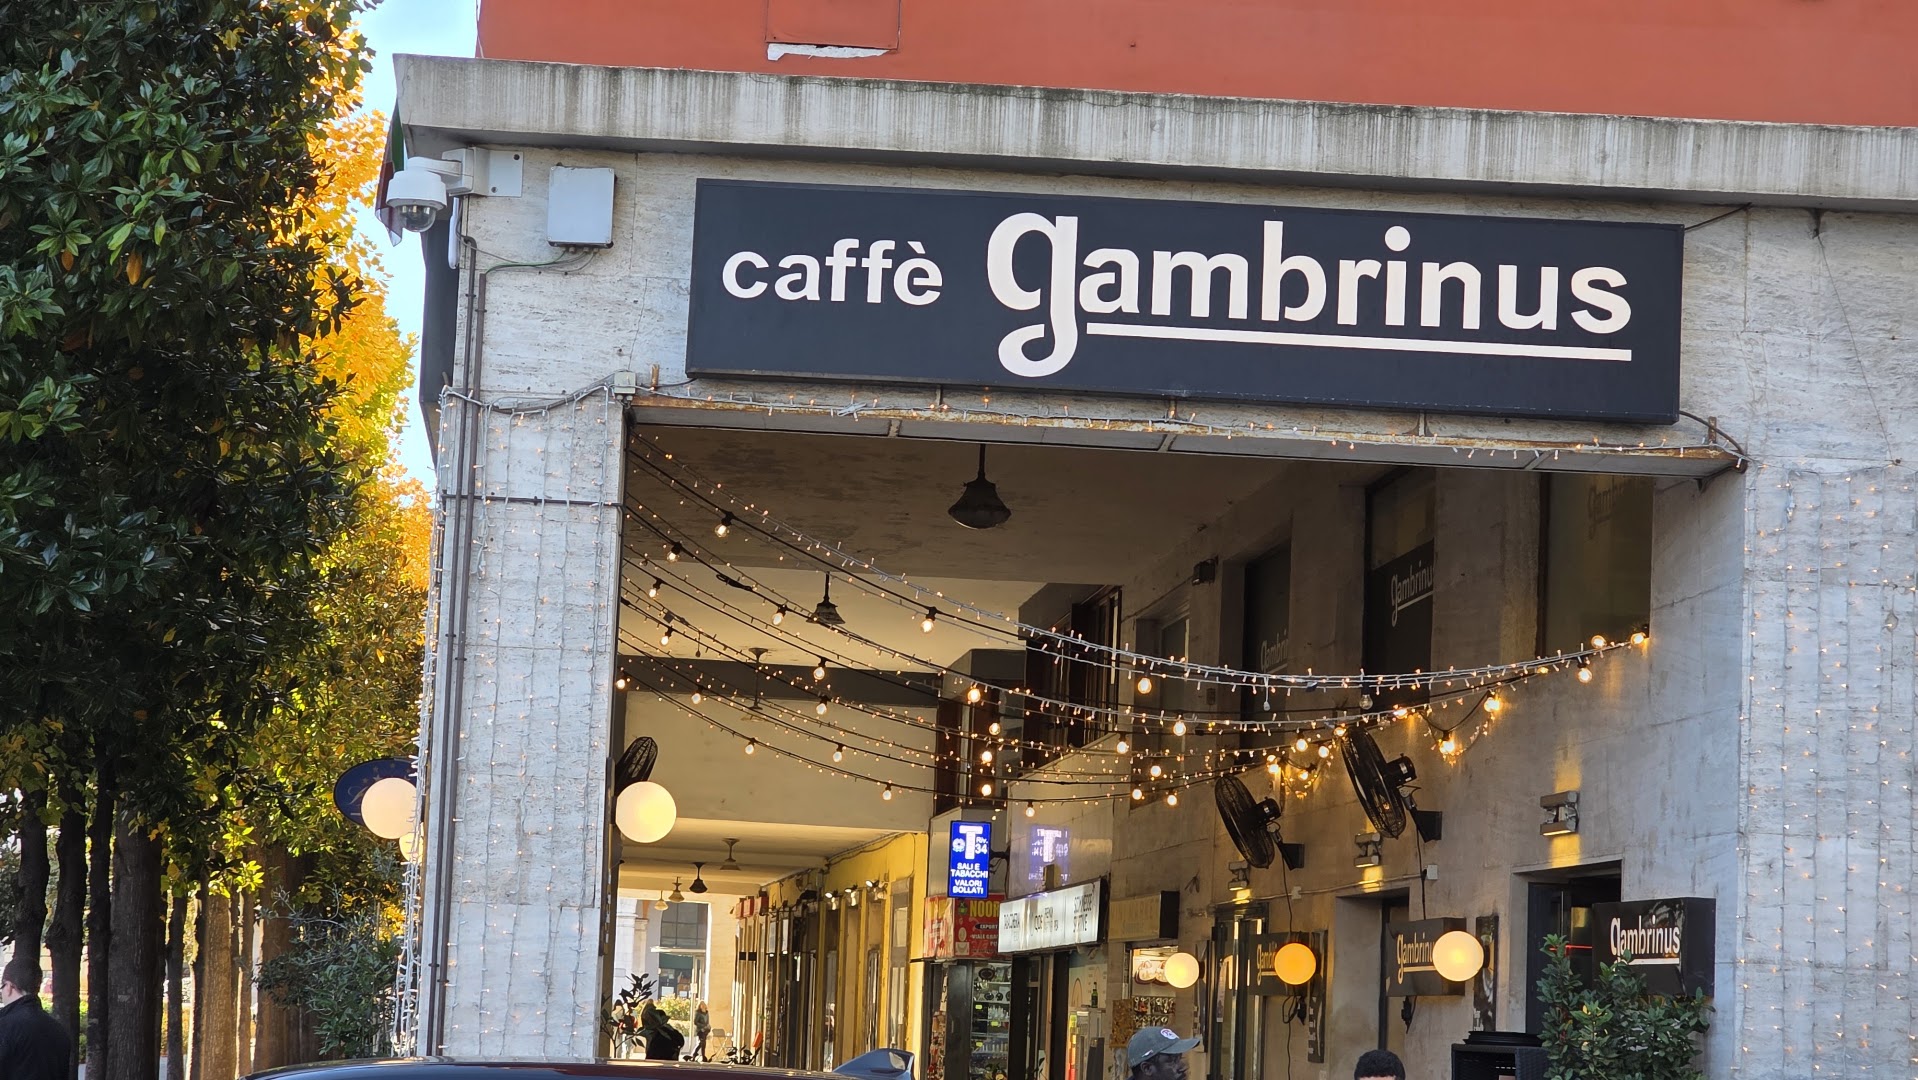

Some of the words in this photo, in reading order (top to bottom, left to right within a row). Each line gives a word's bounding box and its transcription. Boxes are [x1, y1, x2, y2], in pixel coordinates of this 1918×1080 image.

[722, 238, 943, 306] caffè
[987, 212, 1633, 377] gambrinus
[1391, 560, 1434, 627] gambrinu
[959, 825, 983, 860] T
[975, 844, 988, 854] 34
[950, 869, 988, 879] TABACCHI
[954, 879, 982, 887] VALORI
[952, 886, 984, 894] BOLLATI
[1397, 931, 1435, 985] gambrinu
